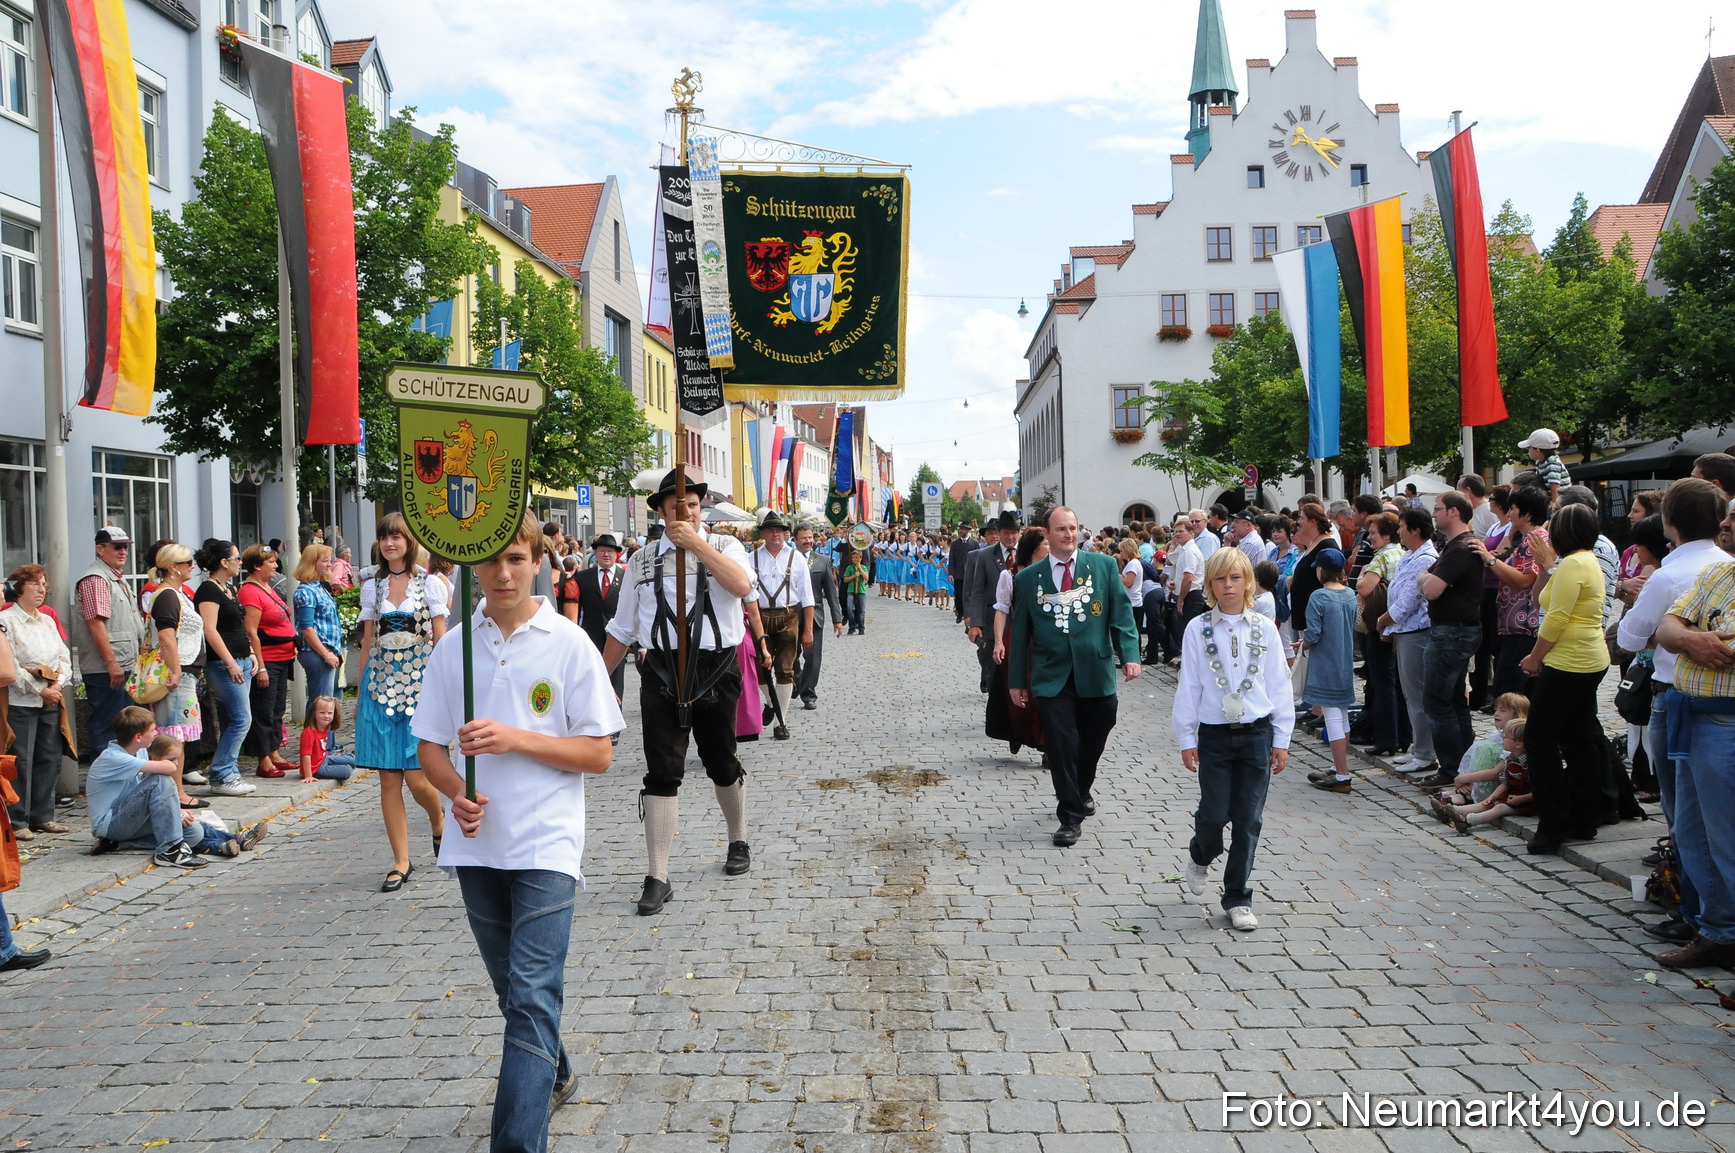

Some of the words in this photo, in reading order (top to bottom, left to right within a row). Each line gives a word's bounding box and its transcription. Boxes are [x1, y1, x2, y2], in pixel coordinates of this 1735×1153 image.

[1300, 105, 1311, 121] XII
[703, 204, 713, 212] 50
[745, 195, 856, 225] Schützengau
[398, 377, 530, 404] SCHÜTZENGAU
[580, 487, 588, 503] P
